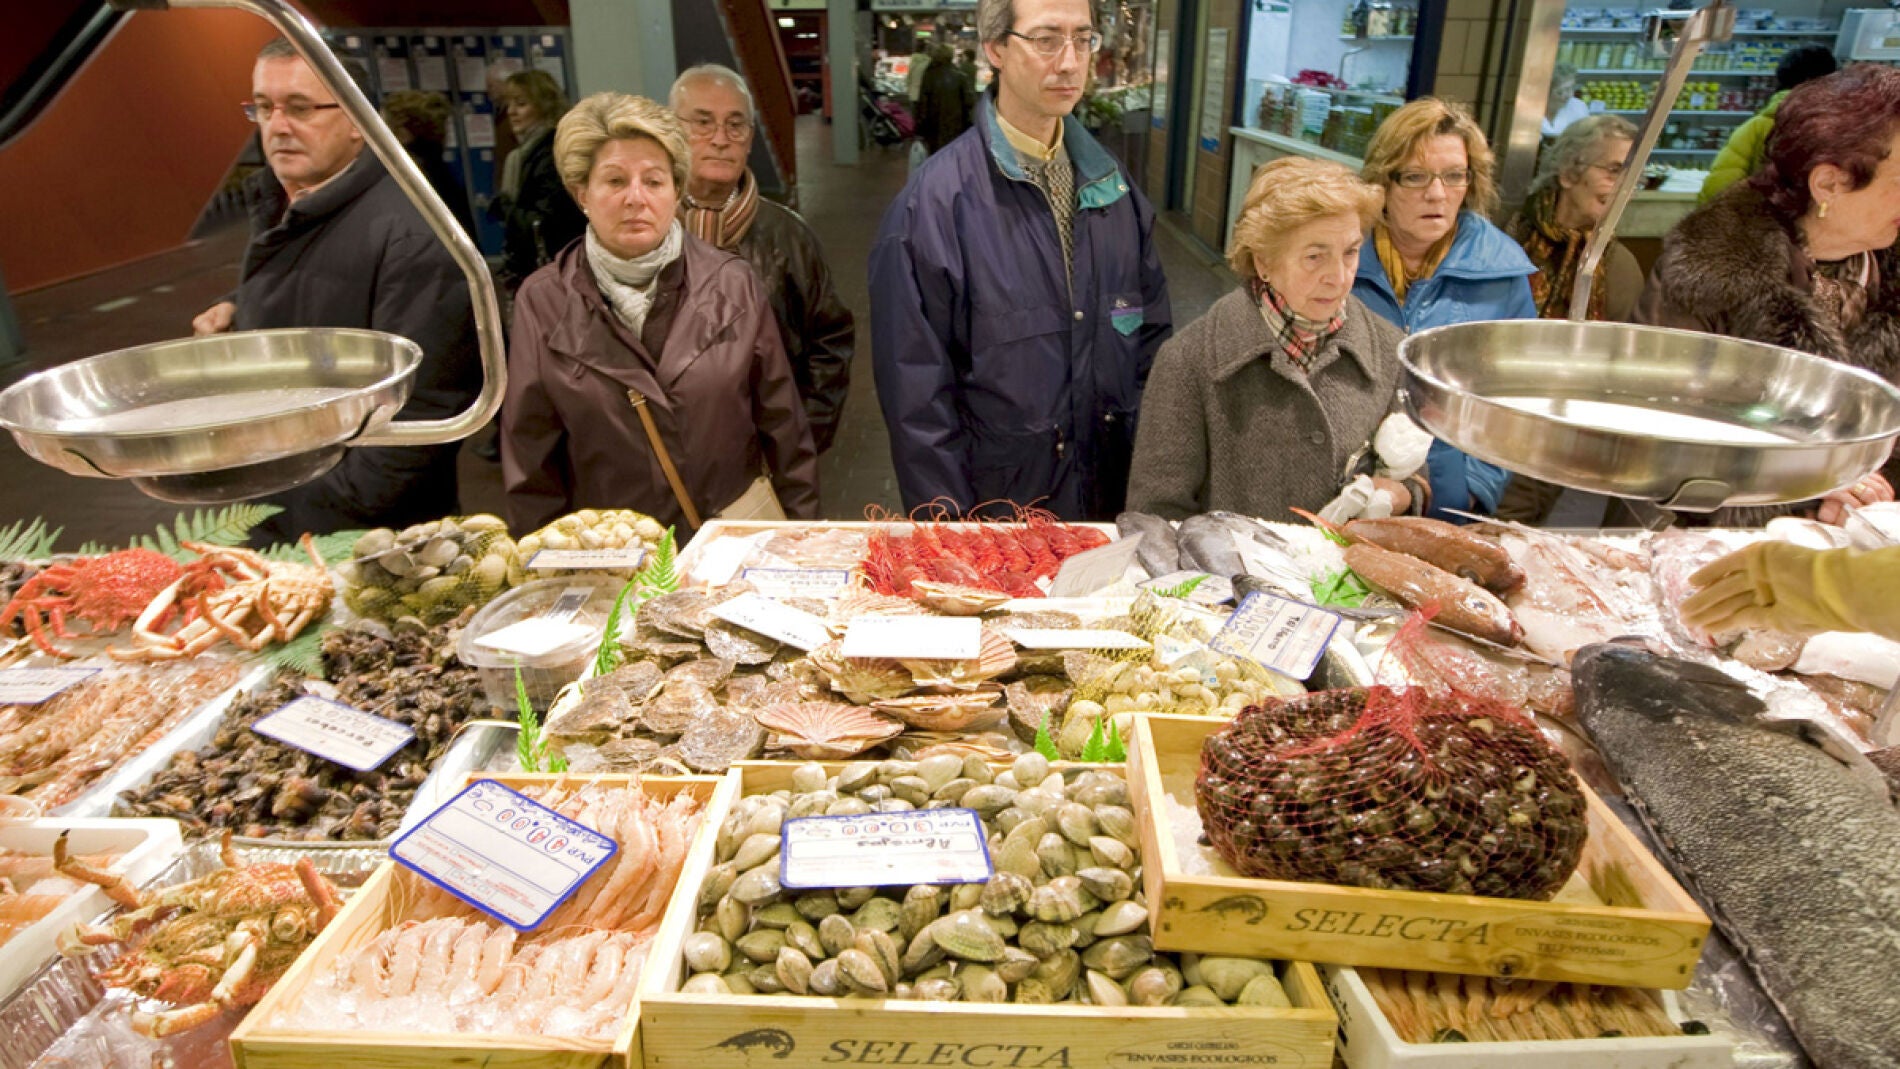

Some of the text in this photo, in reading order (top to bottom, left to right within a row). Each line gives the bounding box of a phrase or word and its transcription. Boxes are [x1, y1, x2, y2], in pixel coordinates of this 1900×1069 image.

[566, 847, 596, 866] PVP
[1285, 907, 1491, 946] SELECTA
[1515, 926, 1574, 942] ENVASES
[821, 1037, 1074, 1069] SELECTA
[1127, 1053, 1279, 1065] ENVASES ECOLOGICOS
